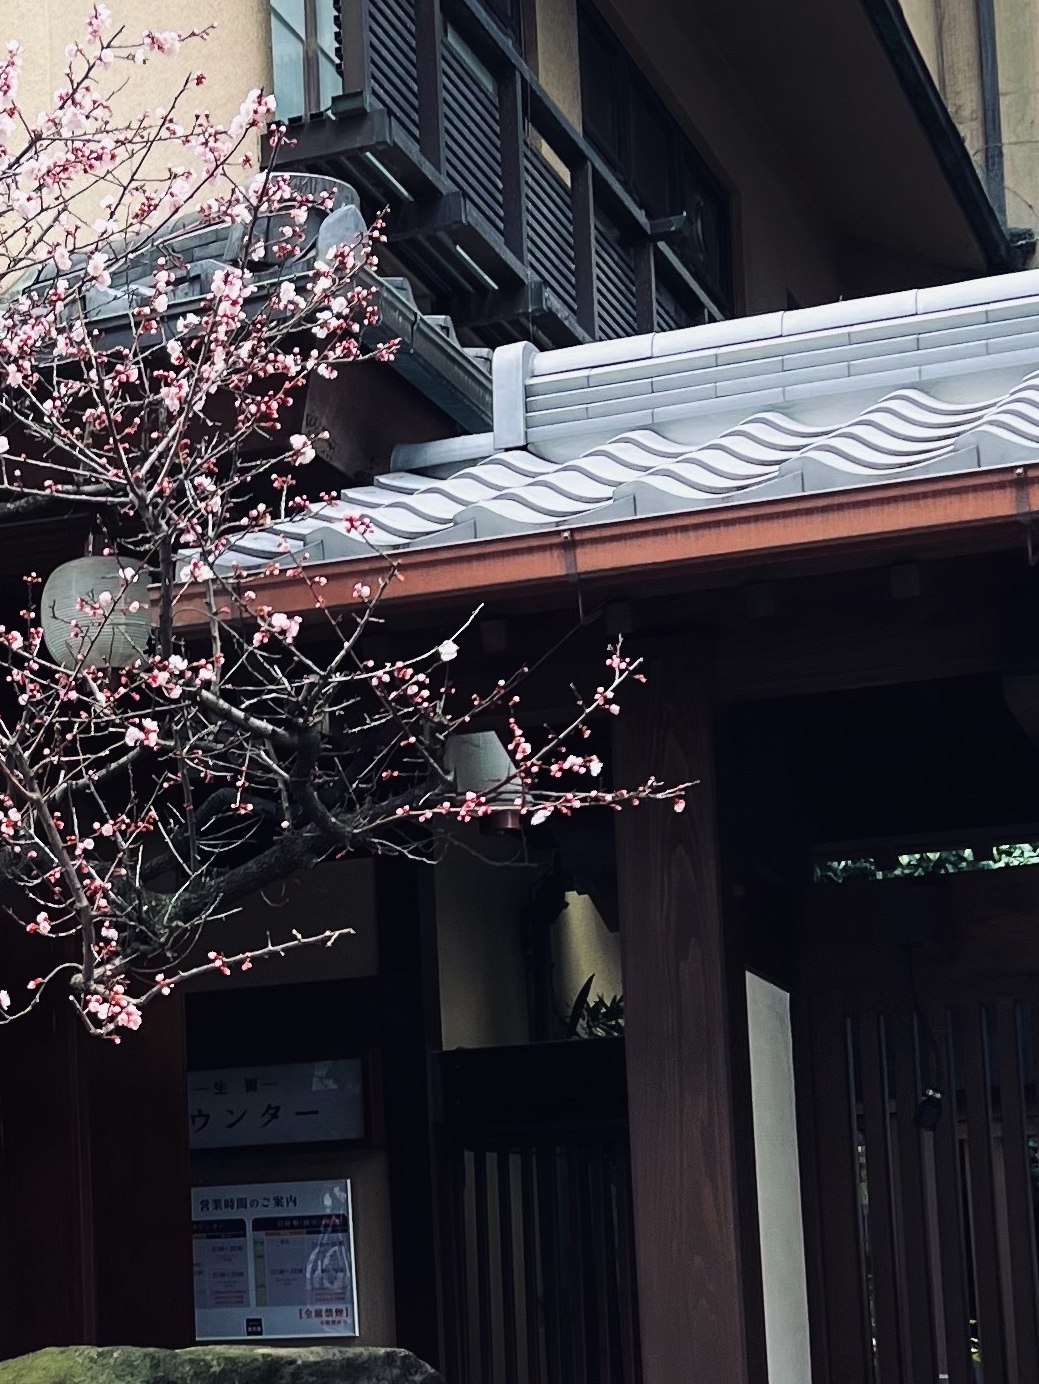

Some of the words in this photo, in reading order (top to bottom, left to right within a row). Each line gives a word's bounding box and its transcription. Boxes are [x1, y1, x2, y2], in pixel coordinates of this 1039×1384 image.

[199, 1194, 298, 1212] 営業時間のご案内
